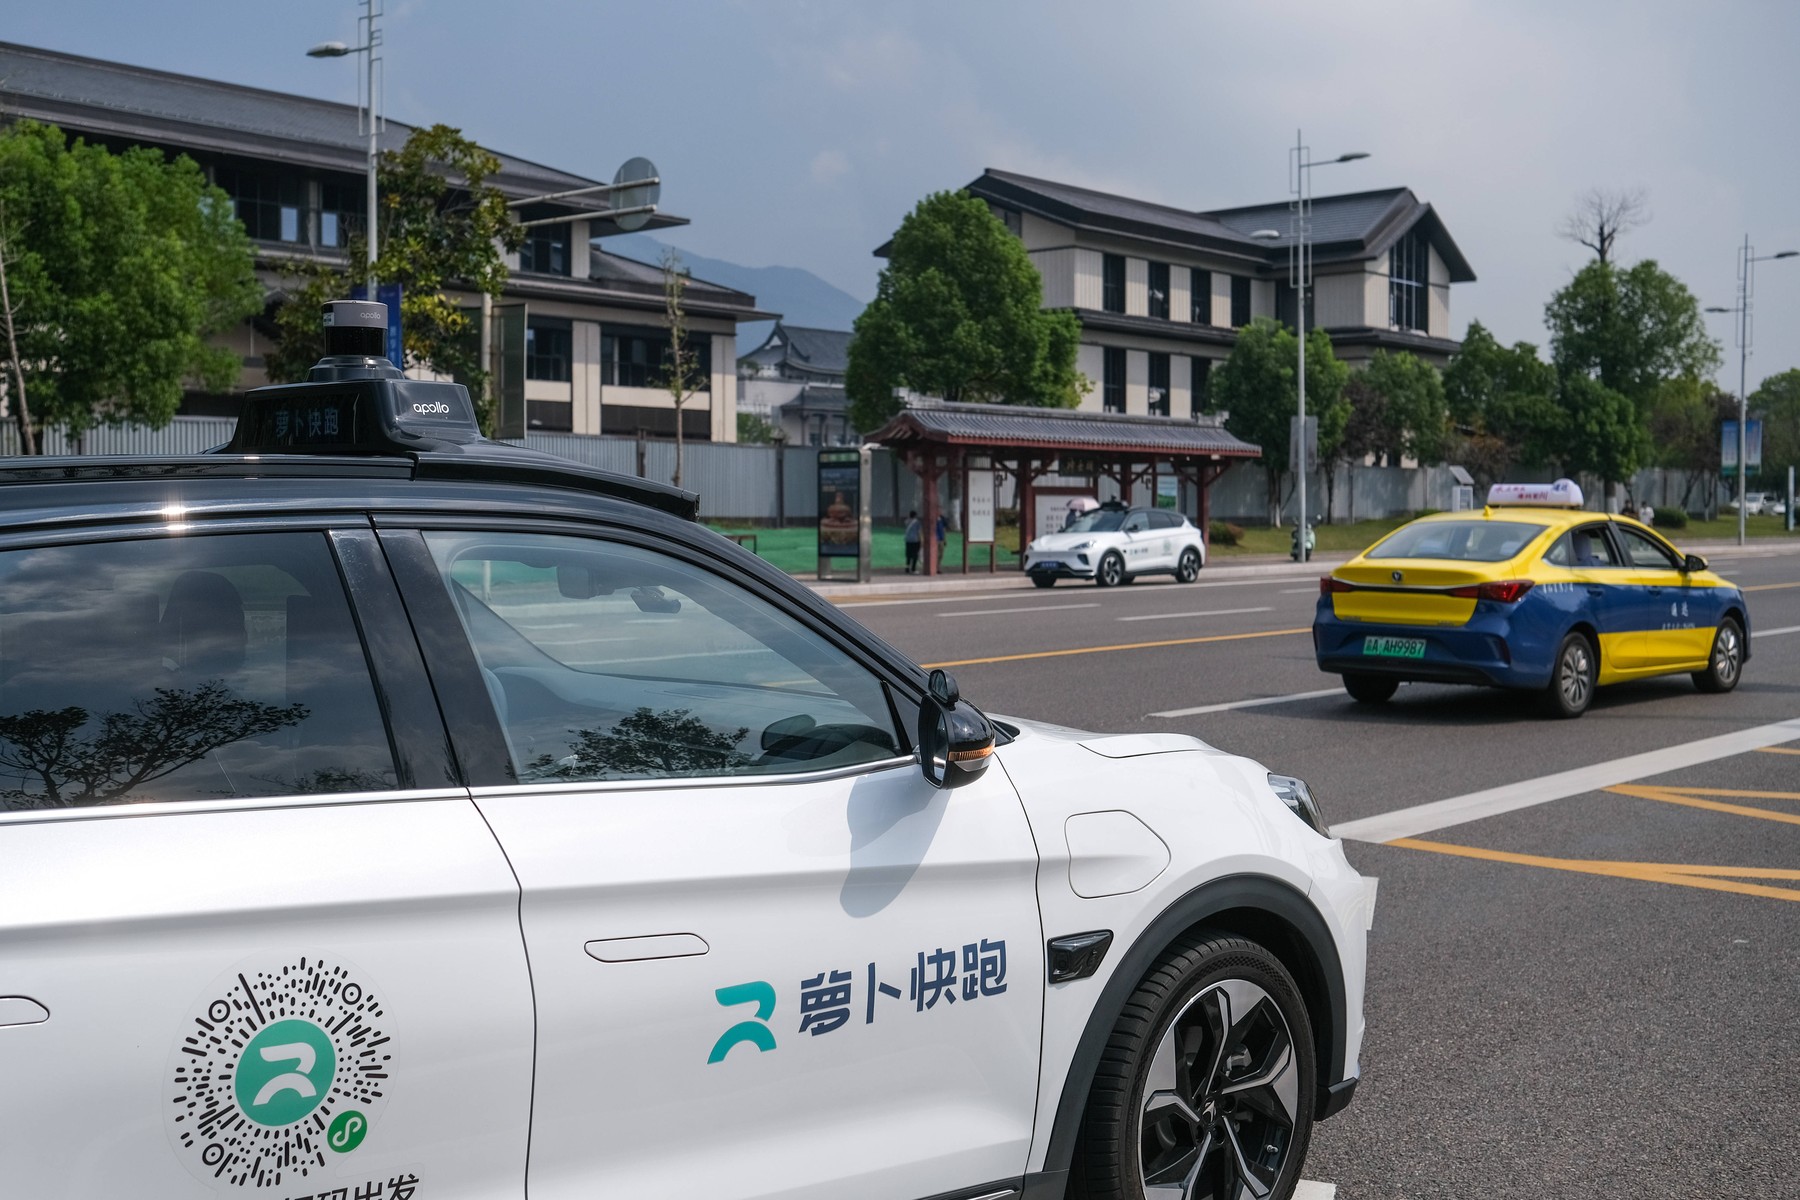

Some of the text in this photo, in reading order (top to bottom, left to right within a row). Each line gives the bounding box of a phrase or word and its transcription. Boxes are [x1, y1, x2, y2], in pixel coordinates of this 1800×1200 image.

[360, 312, 381, 320] apollo
[413, 401, 450, 415] apollo
[275, 407, 339, 437] 萝卜快跑
[1383, 640, 1425, 656] AH9987
[798, 937, 1008, 1036] 萝卜快跑
[284, 1173, 420, 1200] 出发
